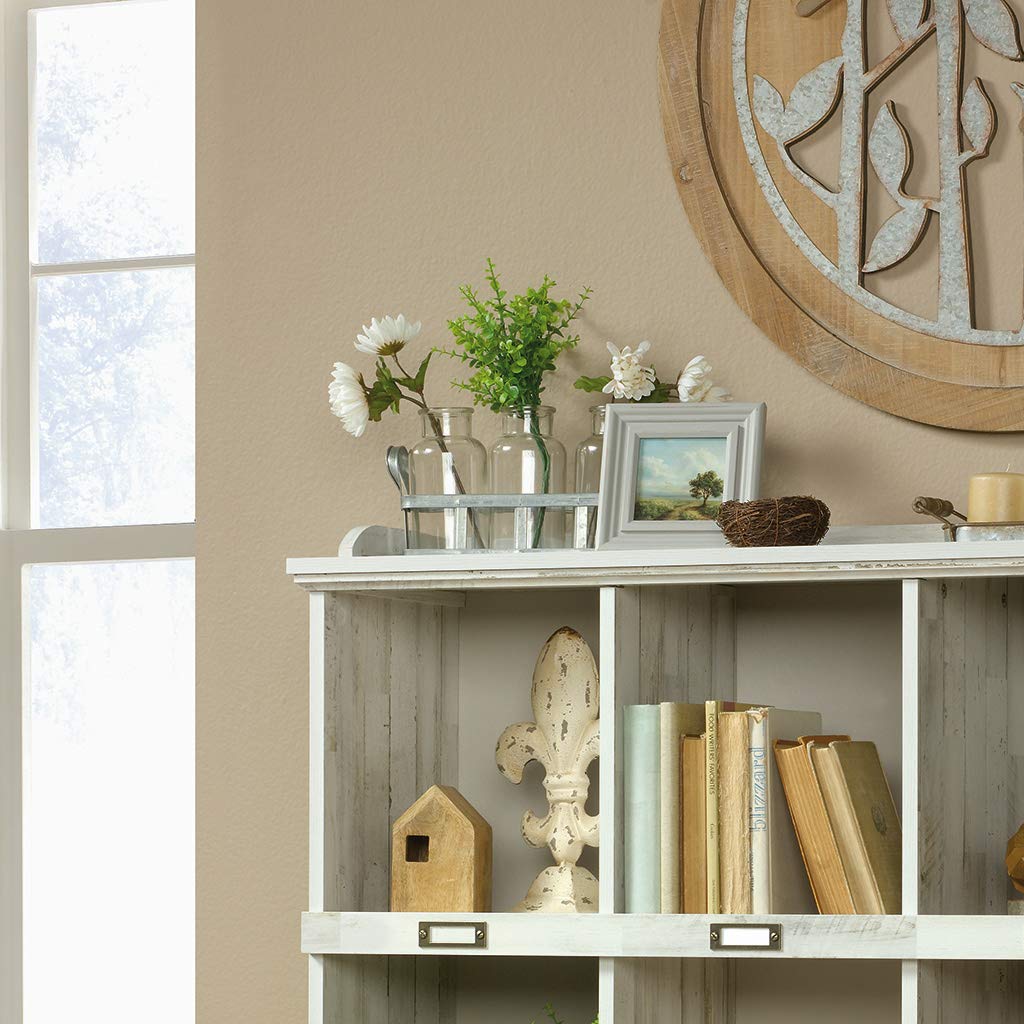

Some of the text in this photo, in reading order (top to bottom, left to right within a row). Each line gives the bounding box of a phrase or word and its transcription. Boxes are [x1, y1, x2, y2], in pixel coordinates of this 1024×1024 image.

[708, 713, 716, 732] FOOD
[708, 763, 716, 795] FAVORITES
[749, 747, 767, 833] blizzard
